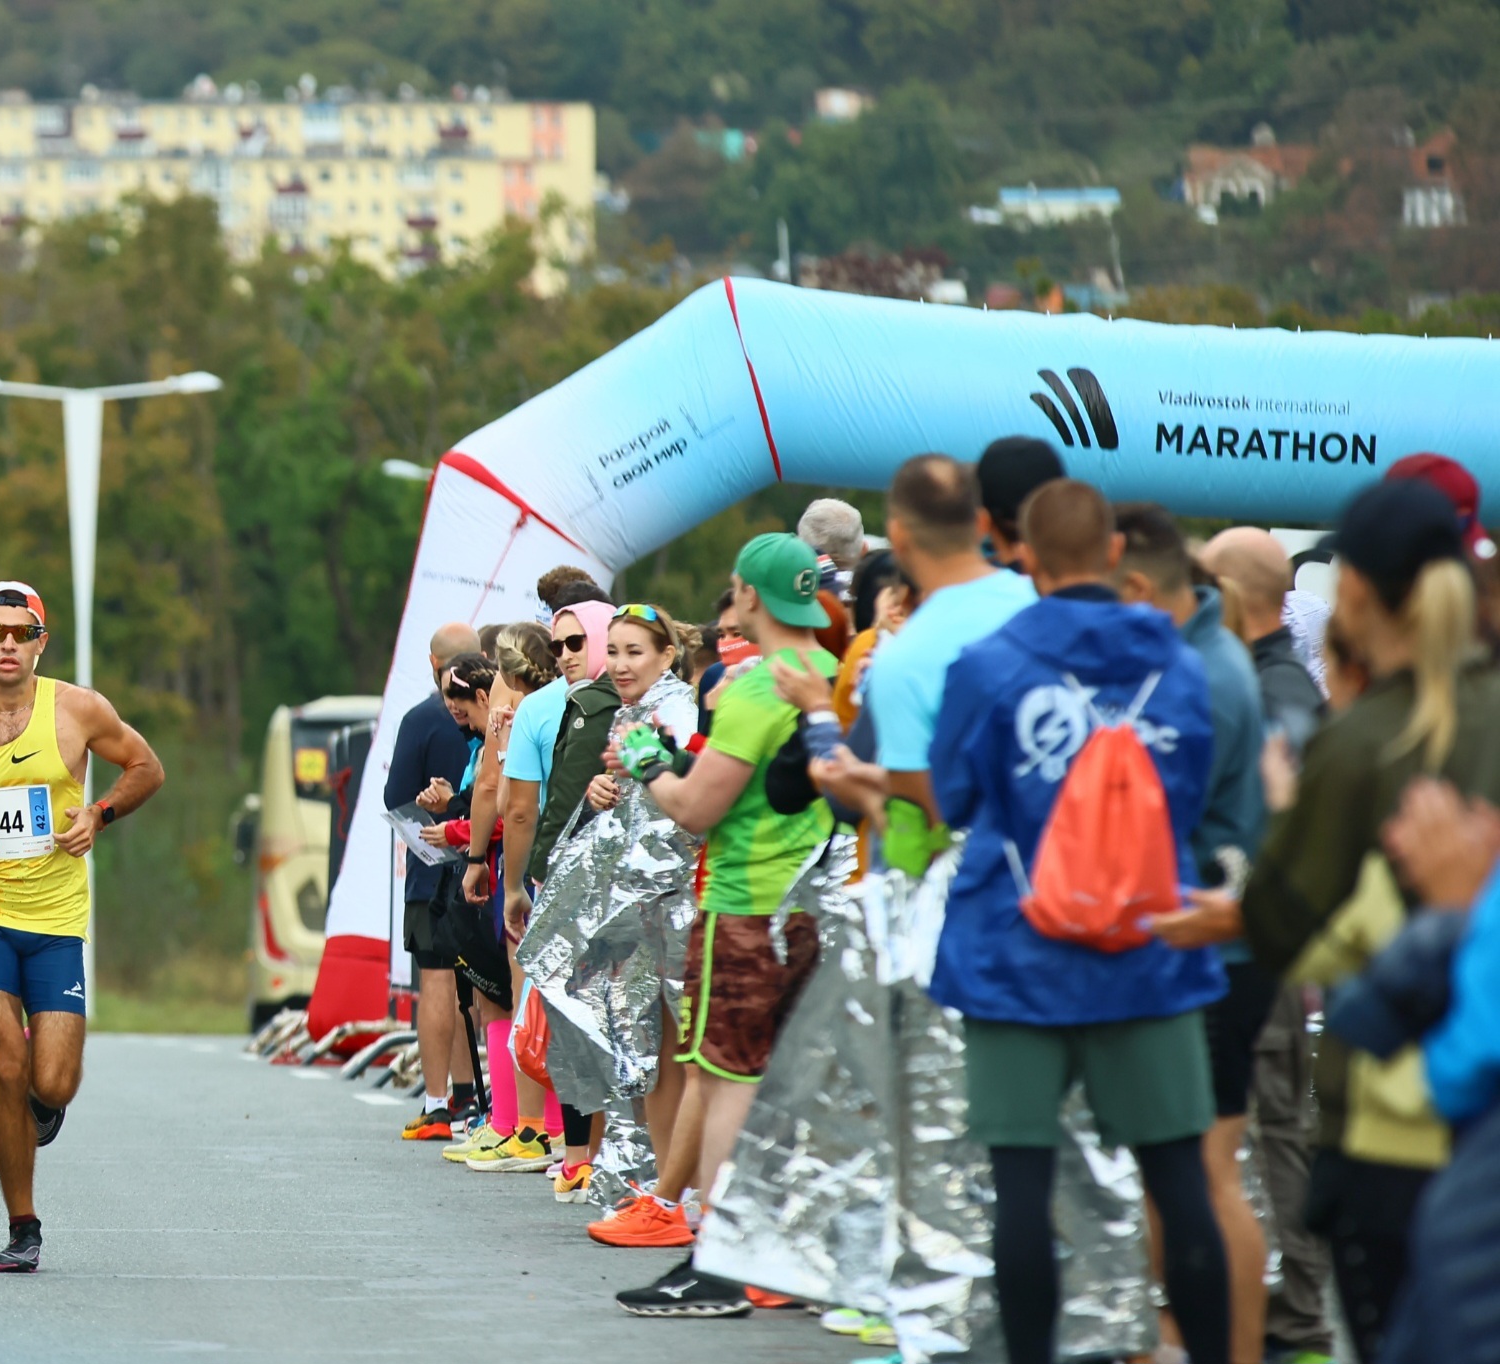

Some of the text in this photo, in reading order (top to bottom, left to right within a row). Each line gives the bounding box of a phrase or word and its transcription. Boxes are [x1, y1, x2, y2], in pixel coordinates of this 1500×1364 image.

[1158, 389, 1350, 416] Vladivostok international
[598, 417, 671, 468] Раскрой
[613, 437, 688, 490] свой мир
[1155, 422, 1377, 466] MARATHON
[34, 804, 46, 830] 42.2
